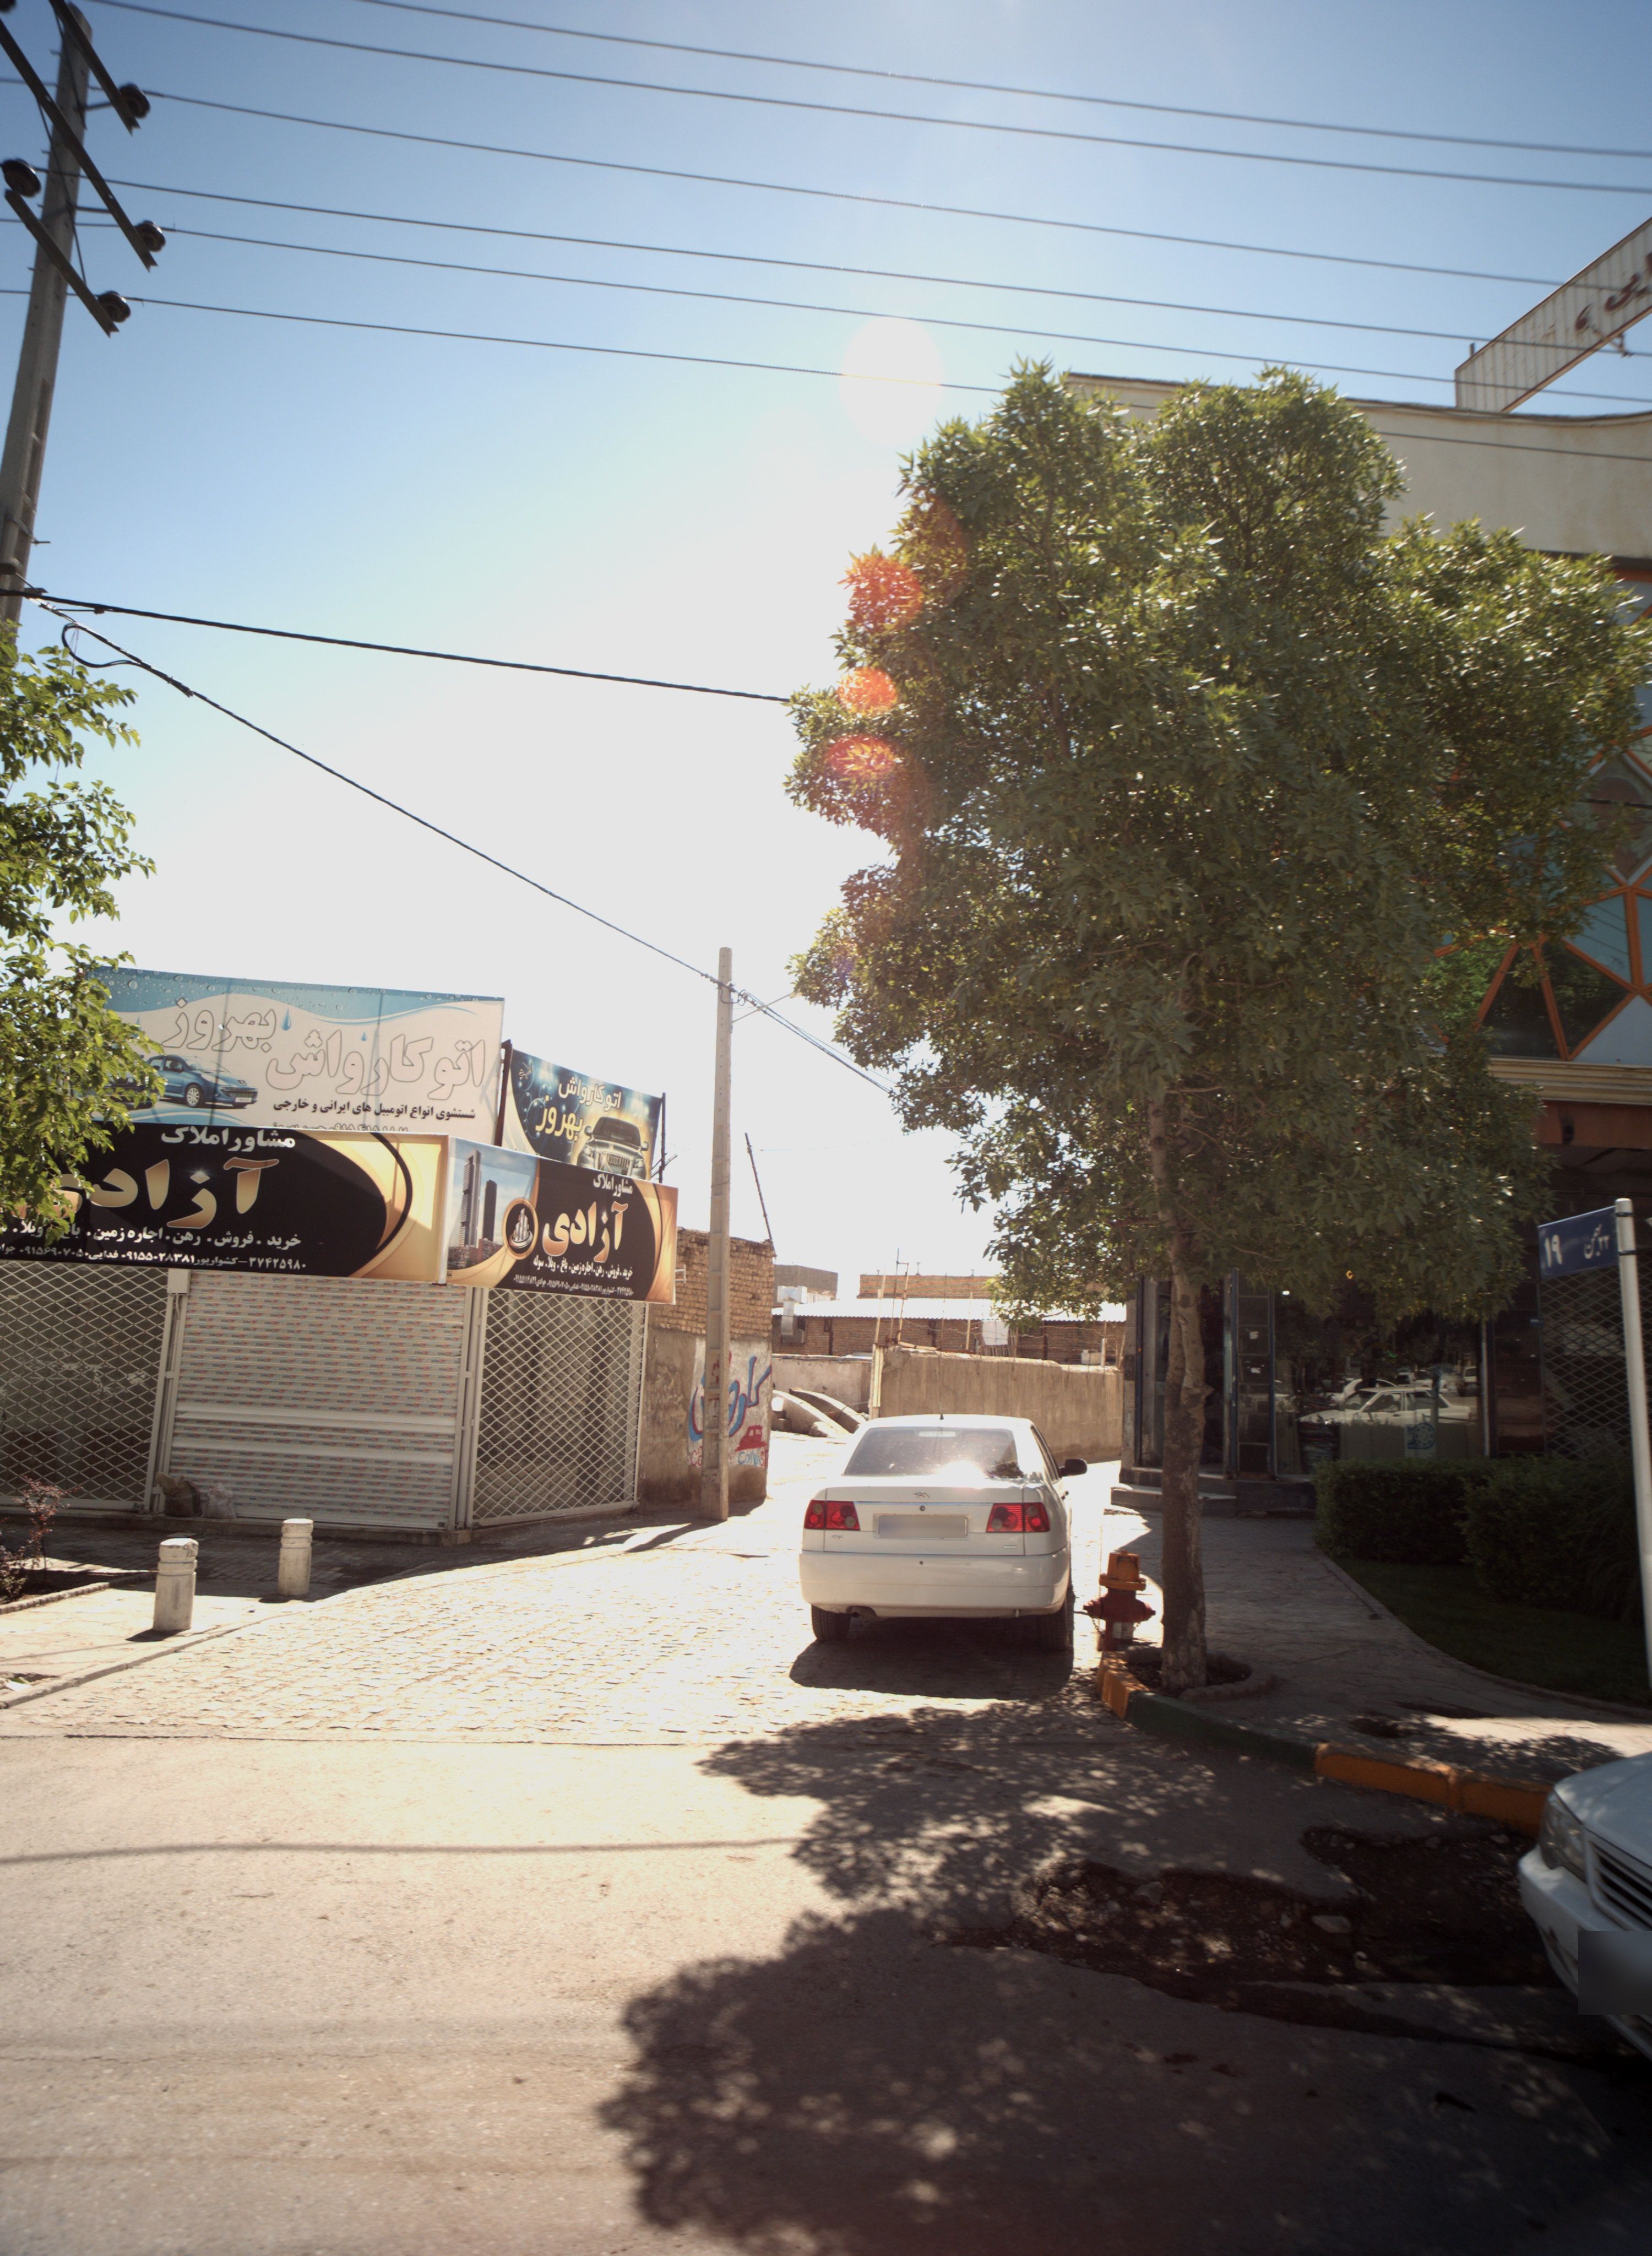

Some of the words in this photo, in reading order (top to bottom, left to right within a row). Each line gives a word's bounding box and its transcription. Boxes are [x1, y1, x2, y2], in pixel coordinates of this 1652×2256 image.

[161, 997, 277, 1053] بهروز
[273, 1098, 309, 1111] خارجی
[312, 1104, 318, 1113] و
[320, 1101, 350, 1114] ایرانی
[352, 1102, 372, 1115] های
[374, 1104, 407, 1118] اتومبیل
[410, 1106, 433, 1119] انواع
[436, 1107, 476, 1120] شستشوی
[535, 1094, 584, 1142] بهروز
[161, 1125, 229, 1145] املاک
[228, 1129, 296, 1152] مشاور
[593, 1173, 615, 1190] املاک
[612, 1178, 633, 1197] مشاور
[93, 1226, 125, 1241] زمین
[127, 1226, 163, 1243] اجاره
[172, 1231, 201, 1246] رهن
[214, 1230, 254, 1248] فروش
[542, 1201, 629, 1263] آزادی
[267, 1234, 302, 1251] خرید
[1544, 1234, 1563, 1268] ۱۹
